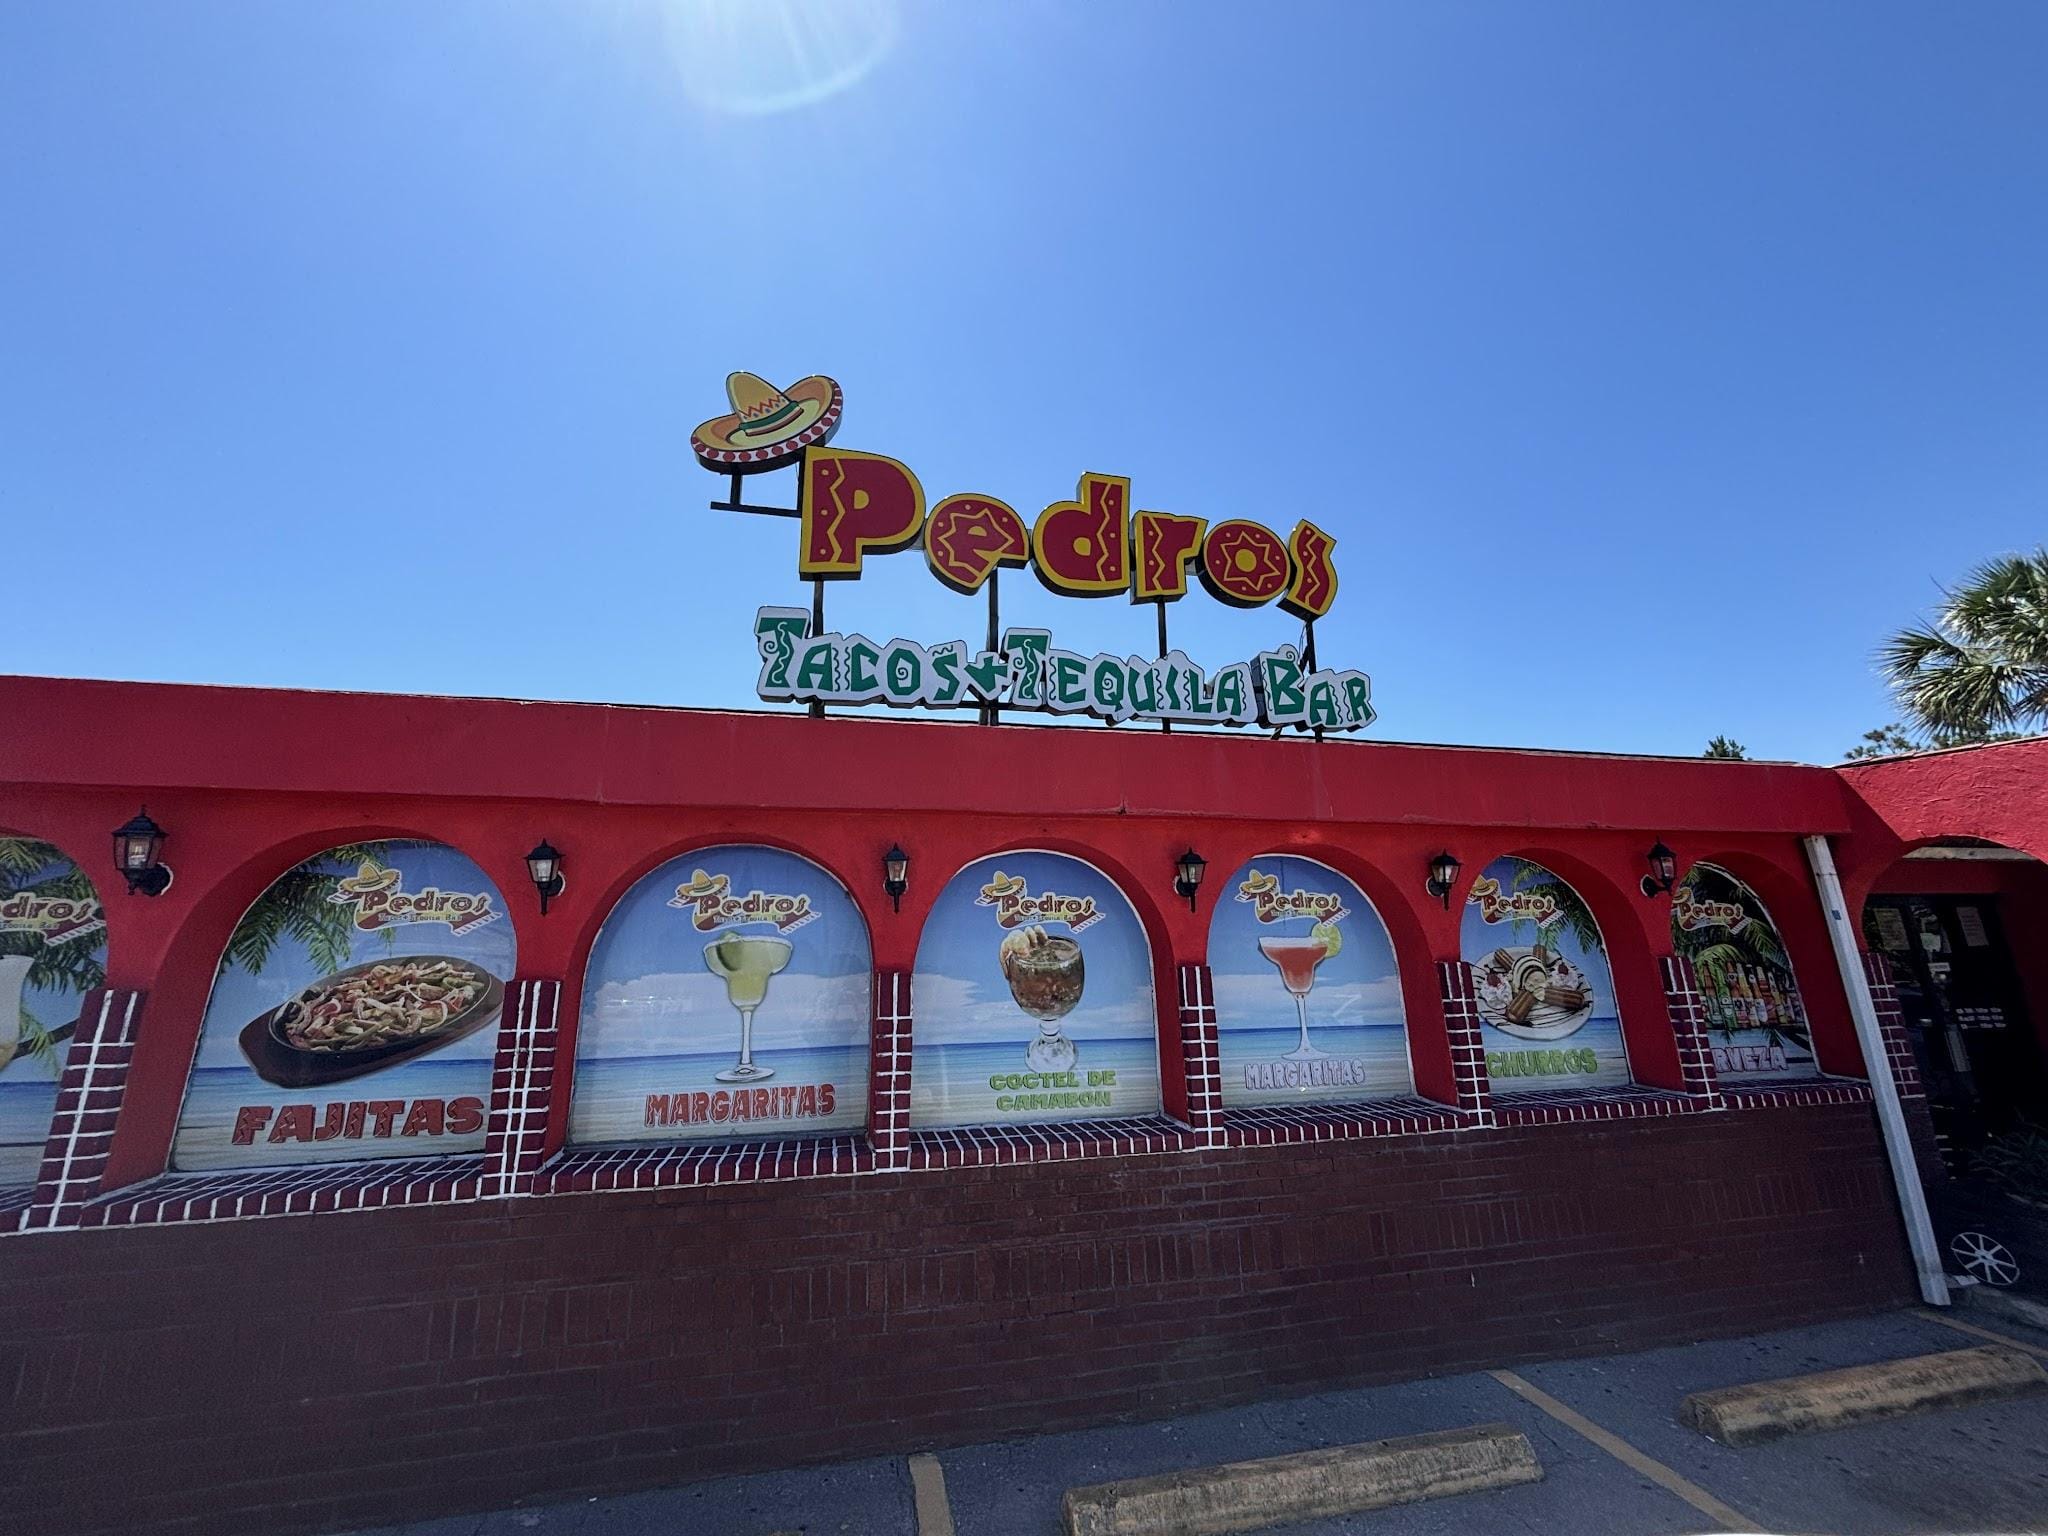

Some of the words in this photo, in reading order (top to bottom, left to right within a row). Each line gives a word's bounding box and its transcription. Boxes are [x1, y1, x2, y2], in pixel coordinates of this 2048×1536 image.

[800, 446, 1337, 615] Pedros
[0, 896, 93, 921] dros
[362, 890, 488, 914] Pedros
[699, 893, 807, 915] Pedros
[1001, 895, 1093, 914] Pedros
[1258, 891, 1339, 910] Pedros
[1482, 895, 1554, 911] Pedros
[1680, 902, 1742, 918] Pedros
[1485, 1047, 1598, 1079] CHURROS
[1711, 1045, 1789, 1074] RVEZA
[989, 1071, 1080, 1091] COCTEL
[1087, 1070, 1117, 1087] DE
[1244, 1057, 1366, 1091] MARGARITAS
[644, 1083, 836, 1128] MARGARITAS
[996, 1090, 1112, 1112] CAMARON
[231, 1096, 485, 1146] FAJITAS
